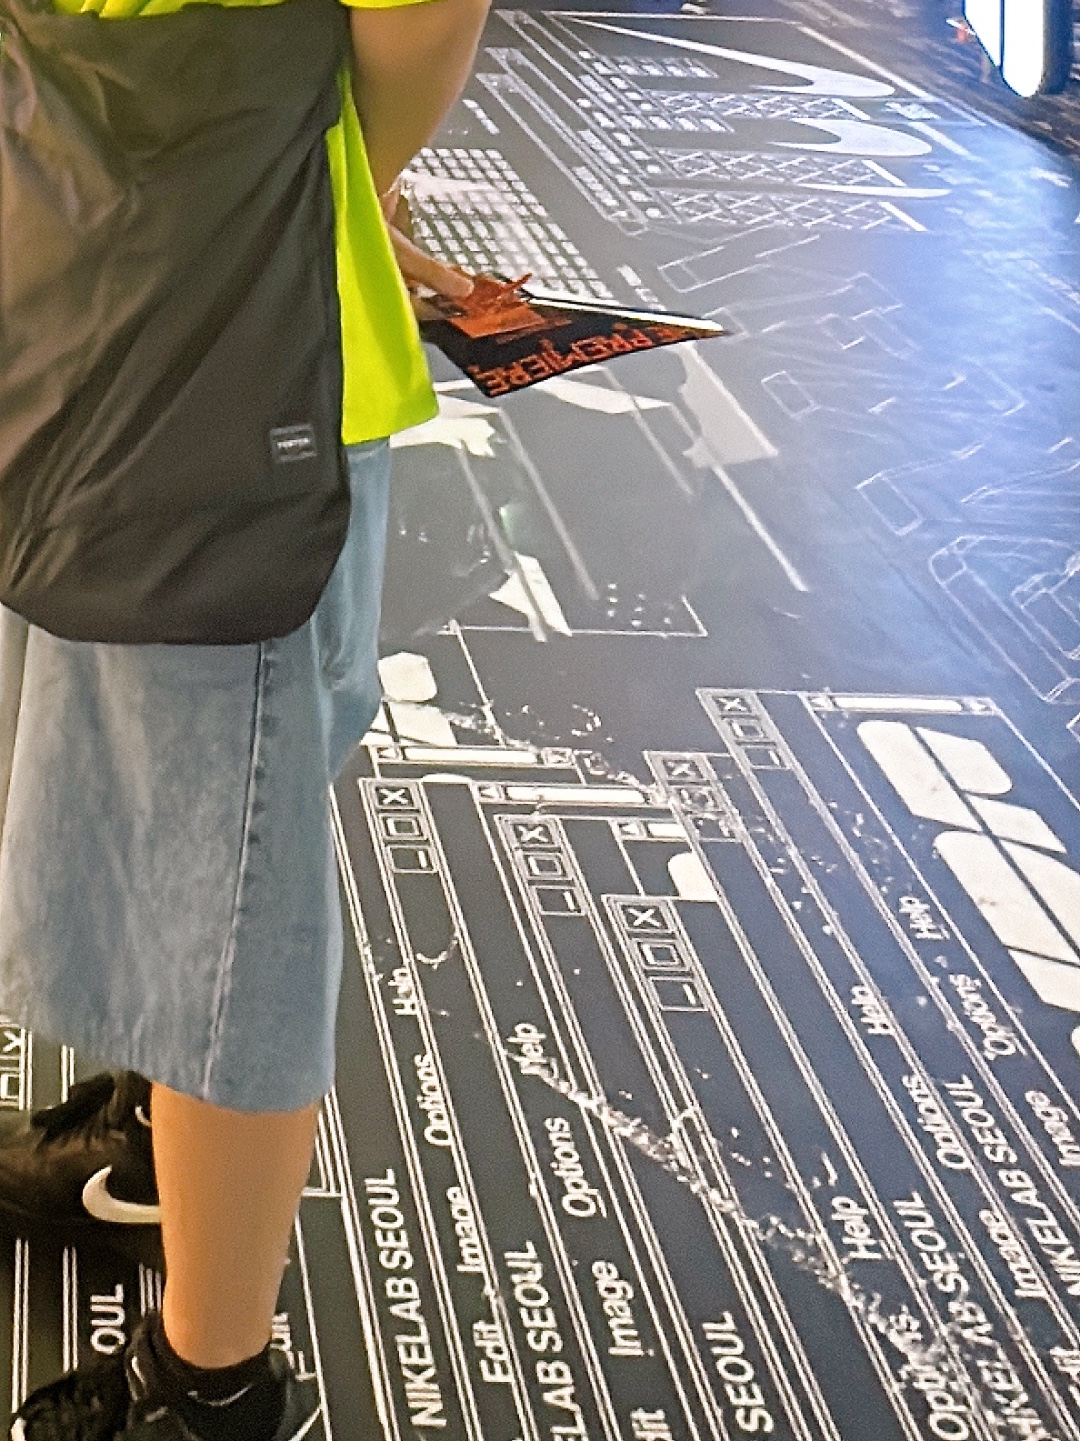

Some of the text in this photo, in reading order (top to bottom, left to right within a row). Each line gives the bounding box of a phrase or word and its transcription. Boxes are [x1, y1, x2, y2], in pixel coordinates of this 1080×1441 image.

[543, 1116, 607, 1219] Options
[944, 1074, 1018, 1164] SEOUL
[831, 1195, 882, 1260] Help
[892, 1191, 970, 1294] SEOUL
[364, 1167, 448, 1428] NIKELAB SEOUL
[503, 1239, 564, 1353] SEOUL
[591, 1260, 636, 1357] Image
[472, 1319, 516, 1383] Edit
[702, 1310, 775, 1434] SEOUL
